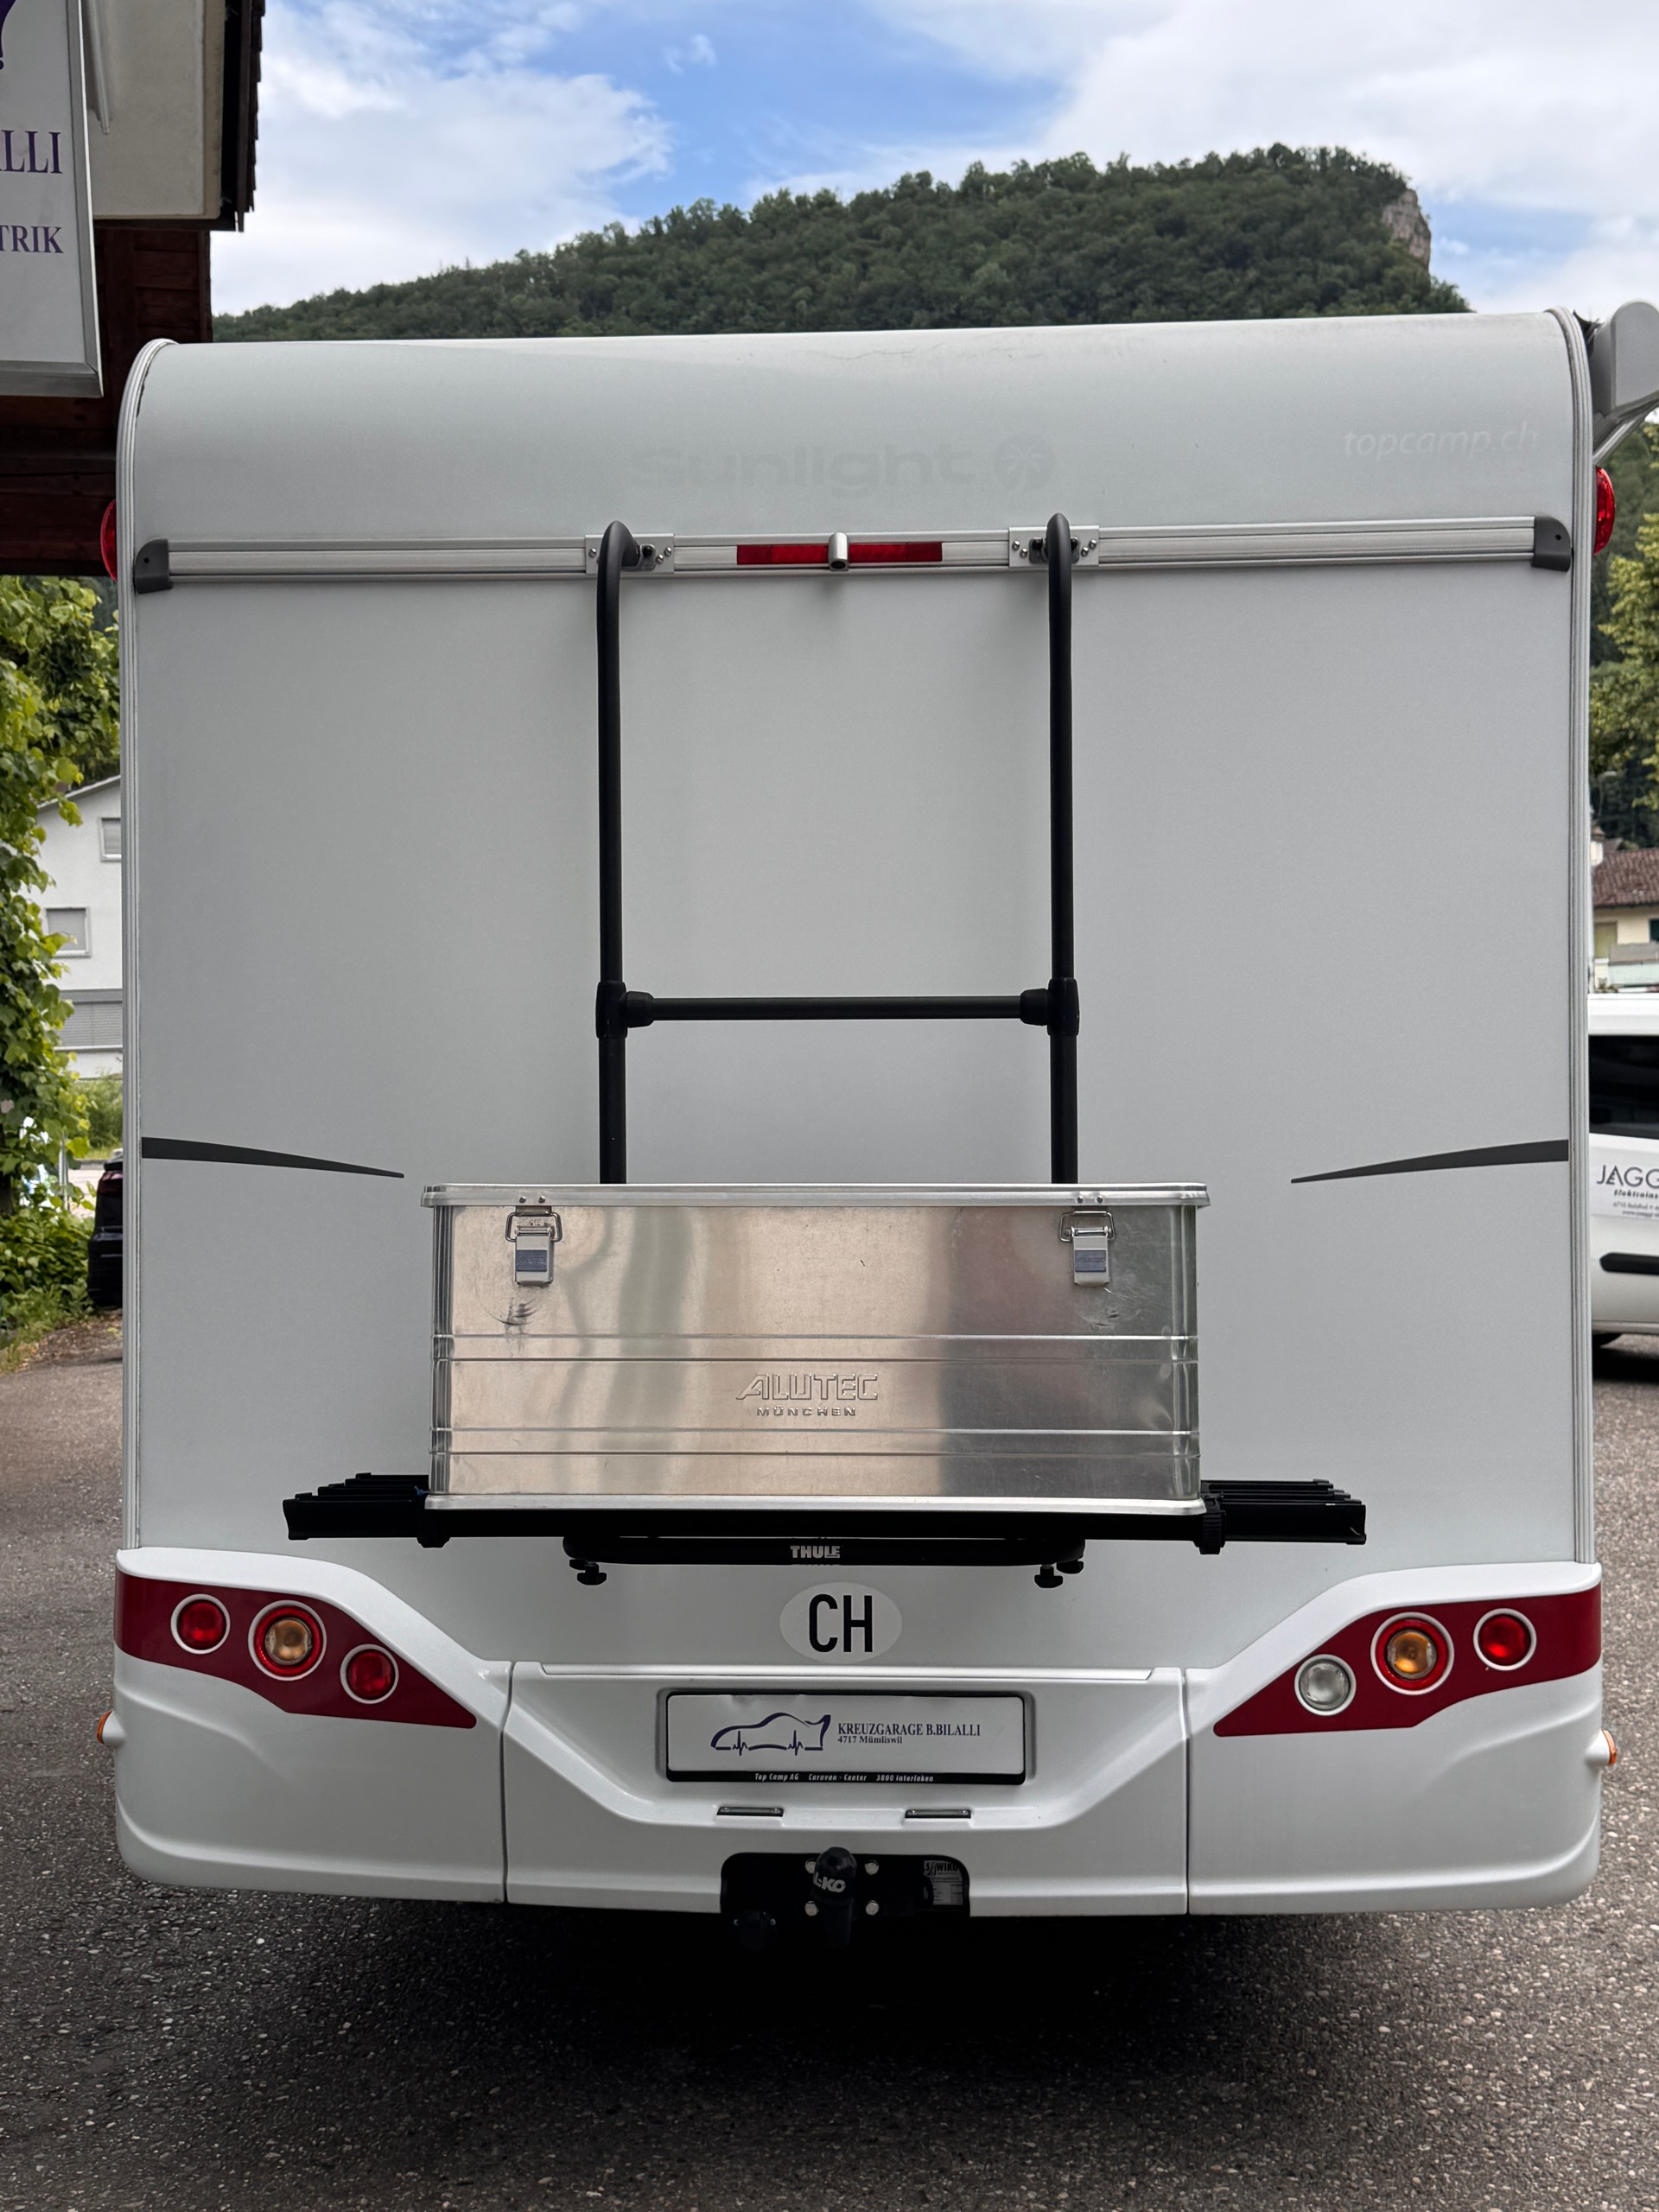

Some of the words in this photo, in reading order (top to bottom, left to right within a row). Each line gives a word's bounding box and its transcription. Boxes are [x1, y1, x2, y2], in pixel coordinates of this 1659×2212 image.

[0, 130, 63, 174] LLI
[1343, 422, 1538, 462] topcamp.ch
[631, 444, 976, 499] Sunlight
[736, 1373, 878, 1401] ALUTEC
[756, 1405, 856, 1417] MÜNCHEN
[790, 1545, 841, 1559] THULE
[809, 1593, 874, 1653] CH
[837, 1722, 924, 1736] KREUZGARAGE
[926, 1724, 981, 1737] B.BILALLI
[754, 1772, 767, 1782] Top
[769, 1772, 788, 1782] Camp
[789, 1772, 799, 1781] AG
[843, 1773, 868, 1782] Center
[895, 1774, 934, 1783] Interlaken
